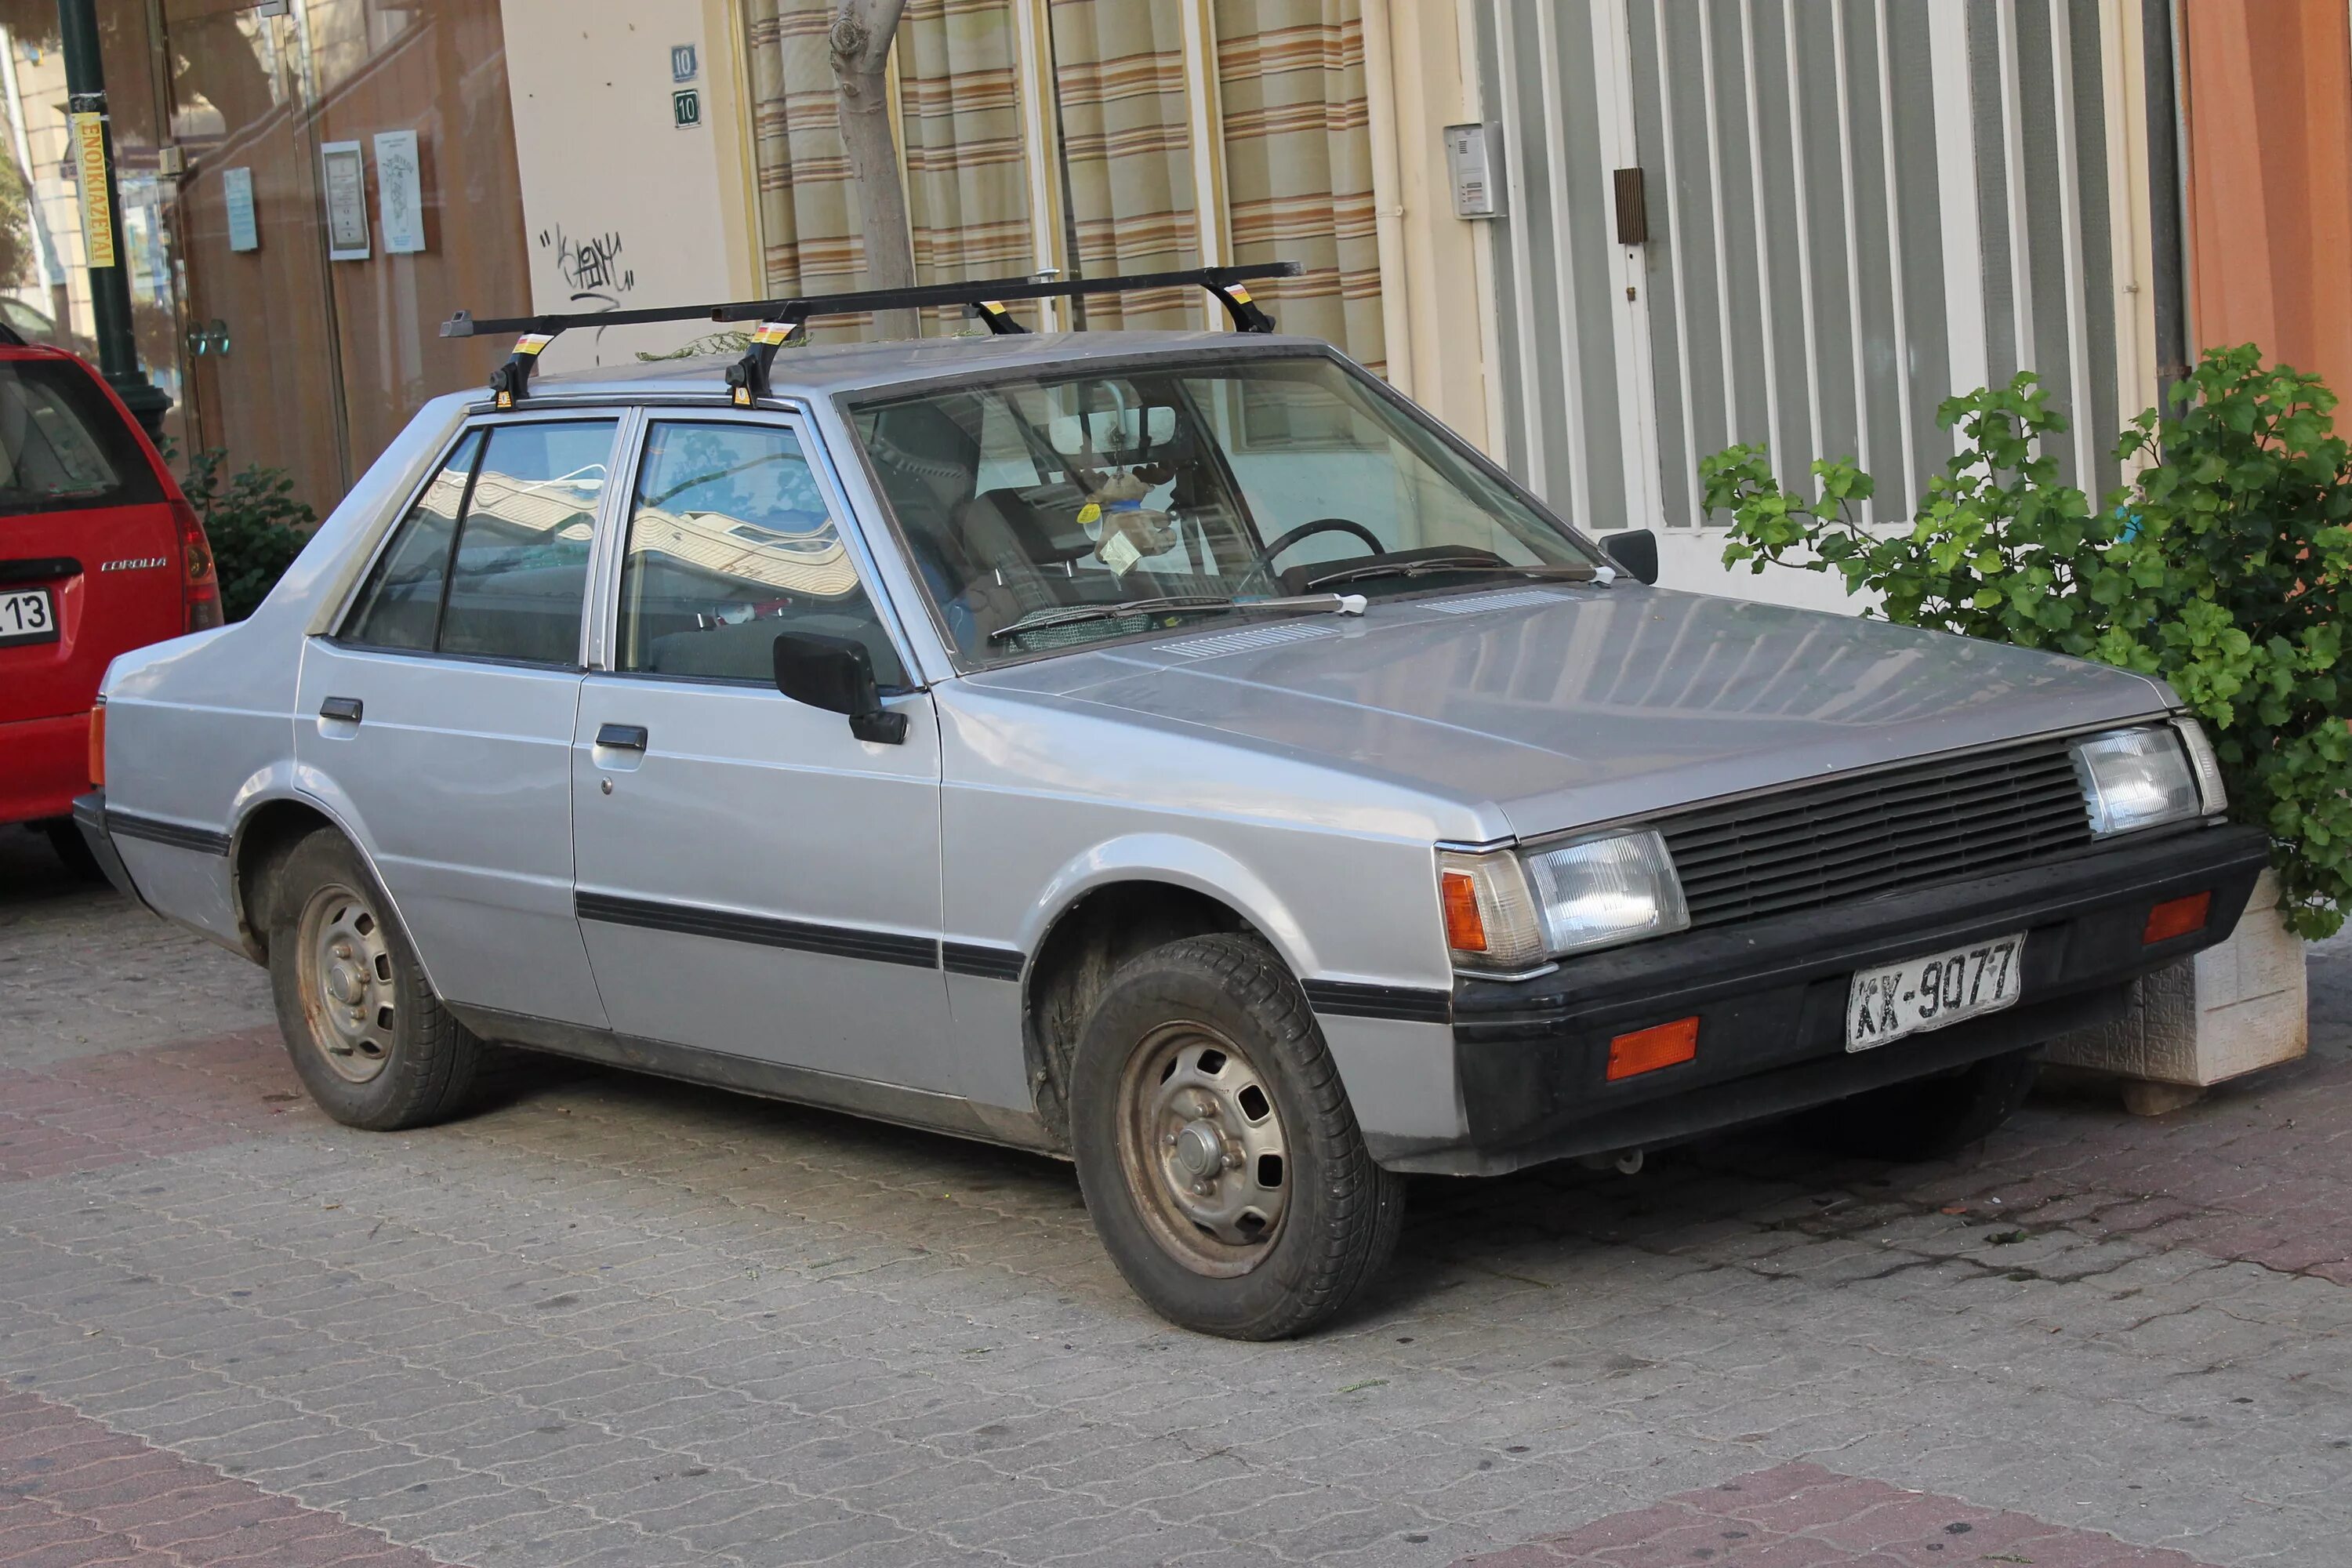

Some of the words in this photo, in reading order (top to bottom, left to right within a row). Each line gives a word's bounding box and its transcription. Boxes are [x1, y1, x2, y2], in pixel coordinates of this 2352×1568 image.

[676, 49, 691, 75] 10
[679, 97, 695, 121] 10
[82, 123, 112, 260] ΕΝΟΙΚΙΑΖΕΤΑΙ
[101, 557, 167, 572] COROLLA
